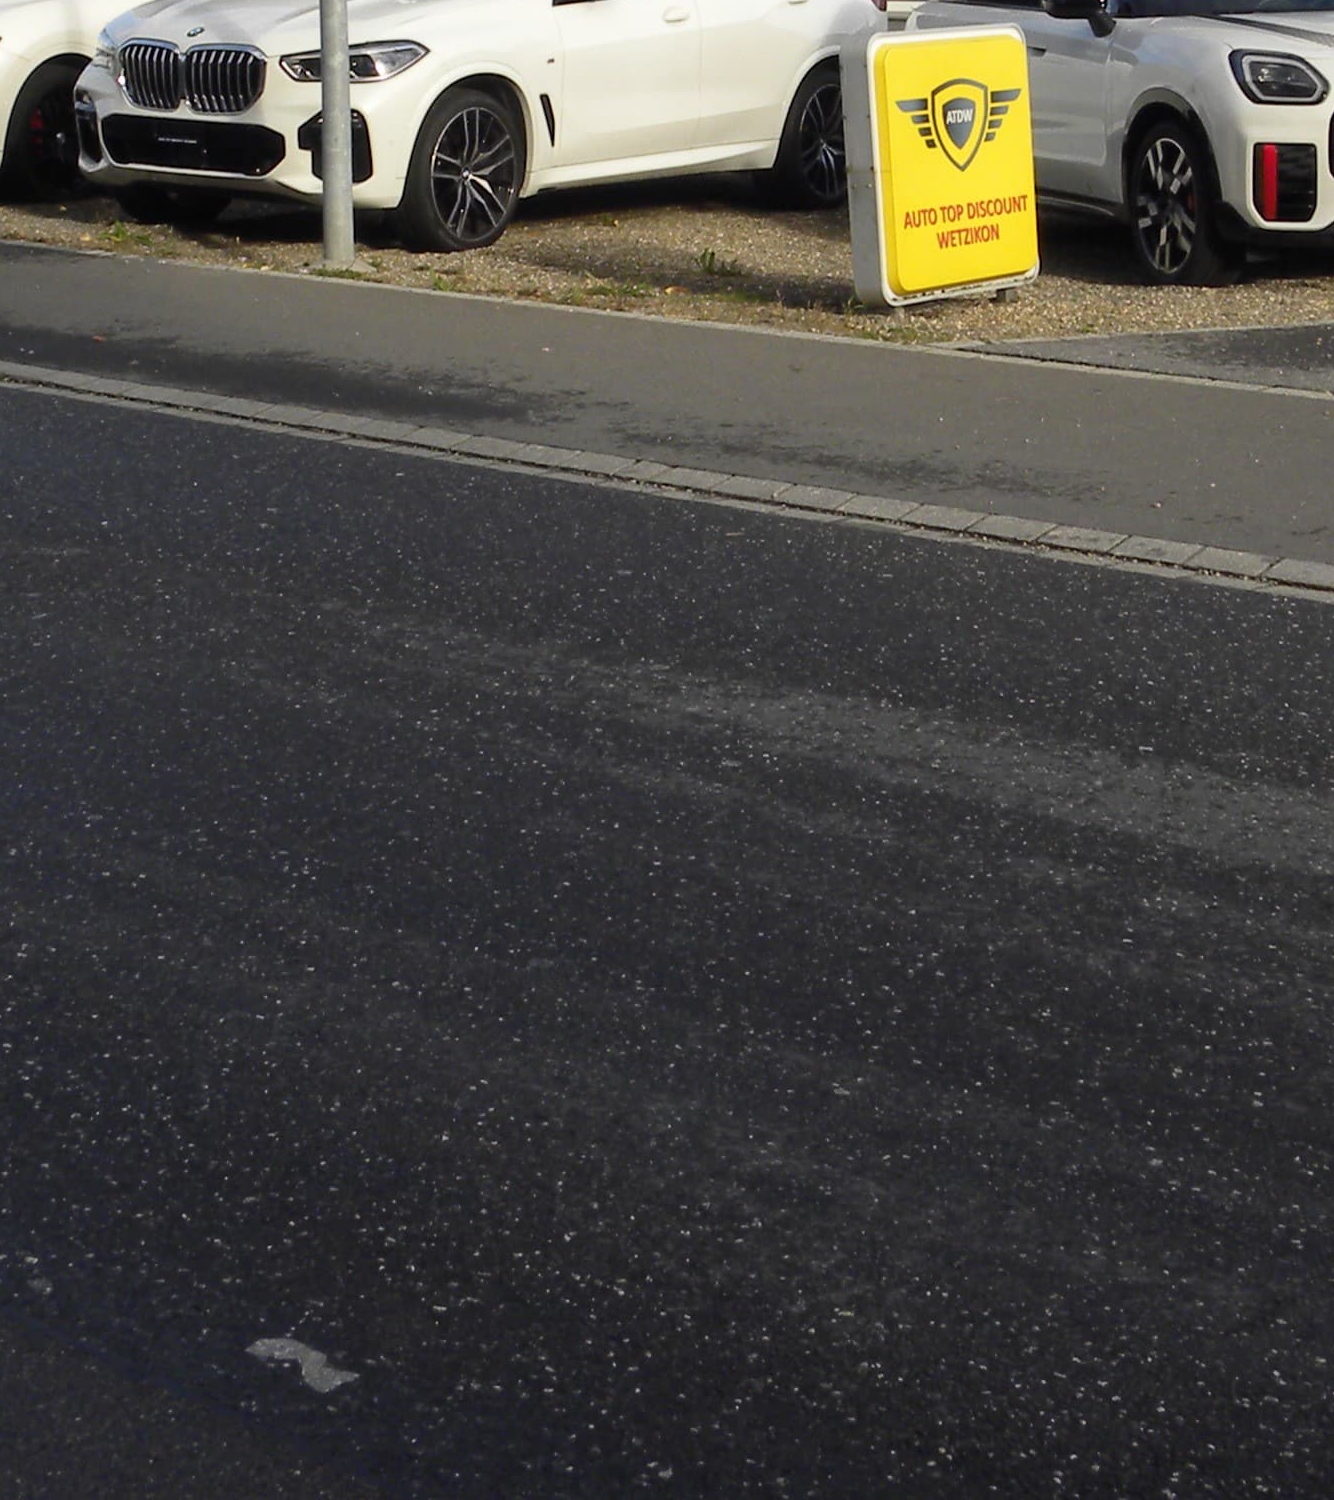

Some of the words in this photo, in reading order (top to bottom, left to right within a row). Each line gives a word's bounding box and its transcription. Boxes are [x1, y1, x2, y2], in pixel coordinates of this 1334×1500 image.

[946, 108, 973, 125] ATDW
[903, 208, 938, 229] AUTO
[939, 204, 964, 223] TOP
[967, 195, 1028, 220] DISCOUNT
[936, 224, 1000, 250] WETZIKON
